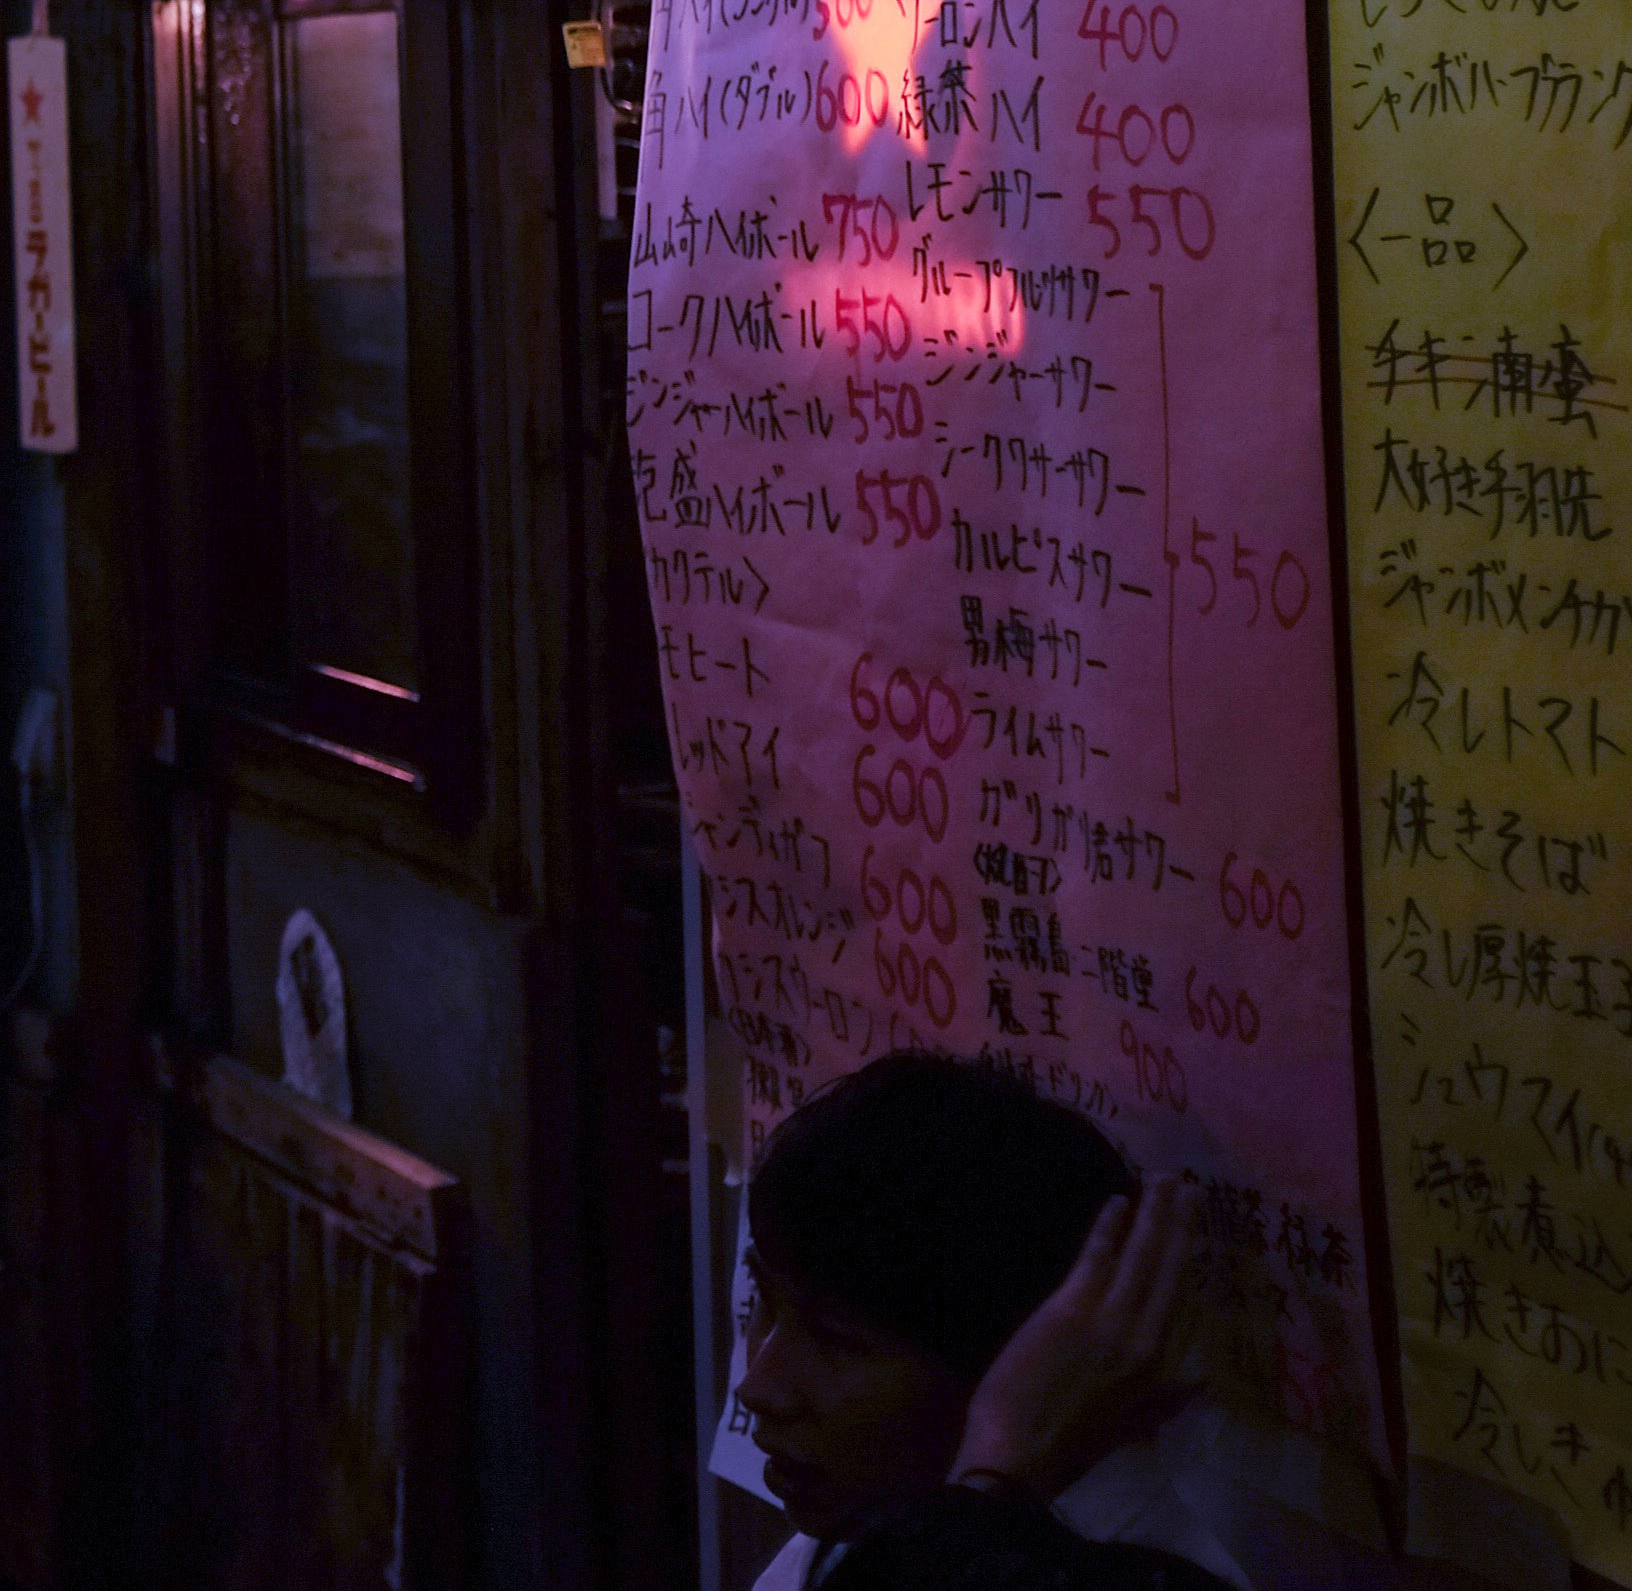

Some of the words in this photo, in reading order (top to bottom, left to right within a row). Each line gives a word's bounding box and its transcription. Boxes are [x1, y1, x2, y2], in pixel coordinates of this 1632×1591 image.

[814, 59, 889, 133] 600
[1076, 91, 1196, 172] 400
[634, 195, 819, 267] 山崎ハイボール
[822, 193, 899, 268] 750
[906, 160, 1062, 230] レモンサワー
[1087, 183, 1215, 260] 550
[627, 281, 825, 361] コークハイボール
[835, 287, 911, 363] 550
[846, 374, 924, 445] 550
[923, 329, 1116, 413] ジンジャーサワー
[855, 468, 942, 549] 550
[951, 507, 1153, 609] カルピスサワー
[1191, 515, 1311, 630] 550
[1379, 538, 1632, 656] ジャンボメンチカ
[849, 650, 965, 761] 600
[971, 691, 1111, 786] ライムサワー
[1386, 650, 1627, 778] 冷しトマト
[853, 742, 949, 844] 600
[1380, 769, 1609, 895] 焼きそば
[860, 843, 958, 946] 600
[1219, 850, 1306, 939] 600
[875, 925, 958, 1029] 600
[1185, 963, 1261, 1046] 600
[1120, 1018, 1187, 1115] 900
